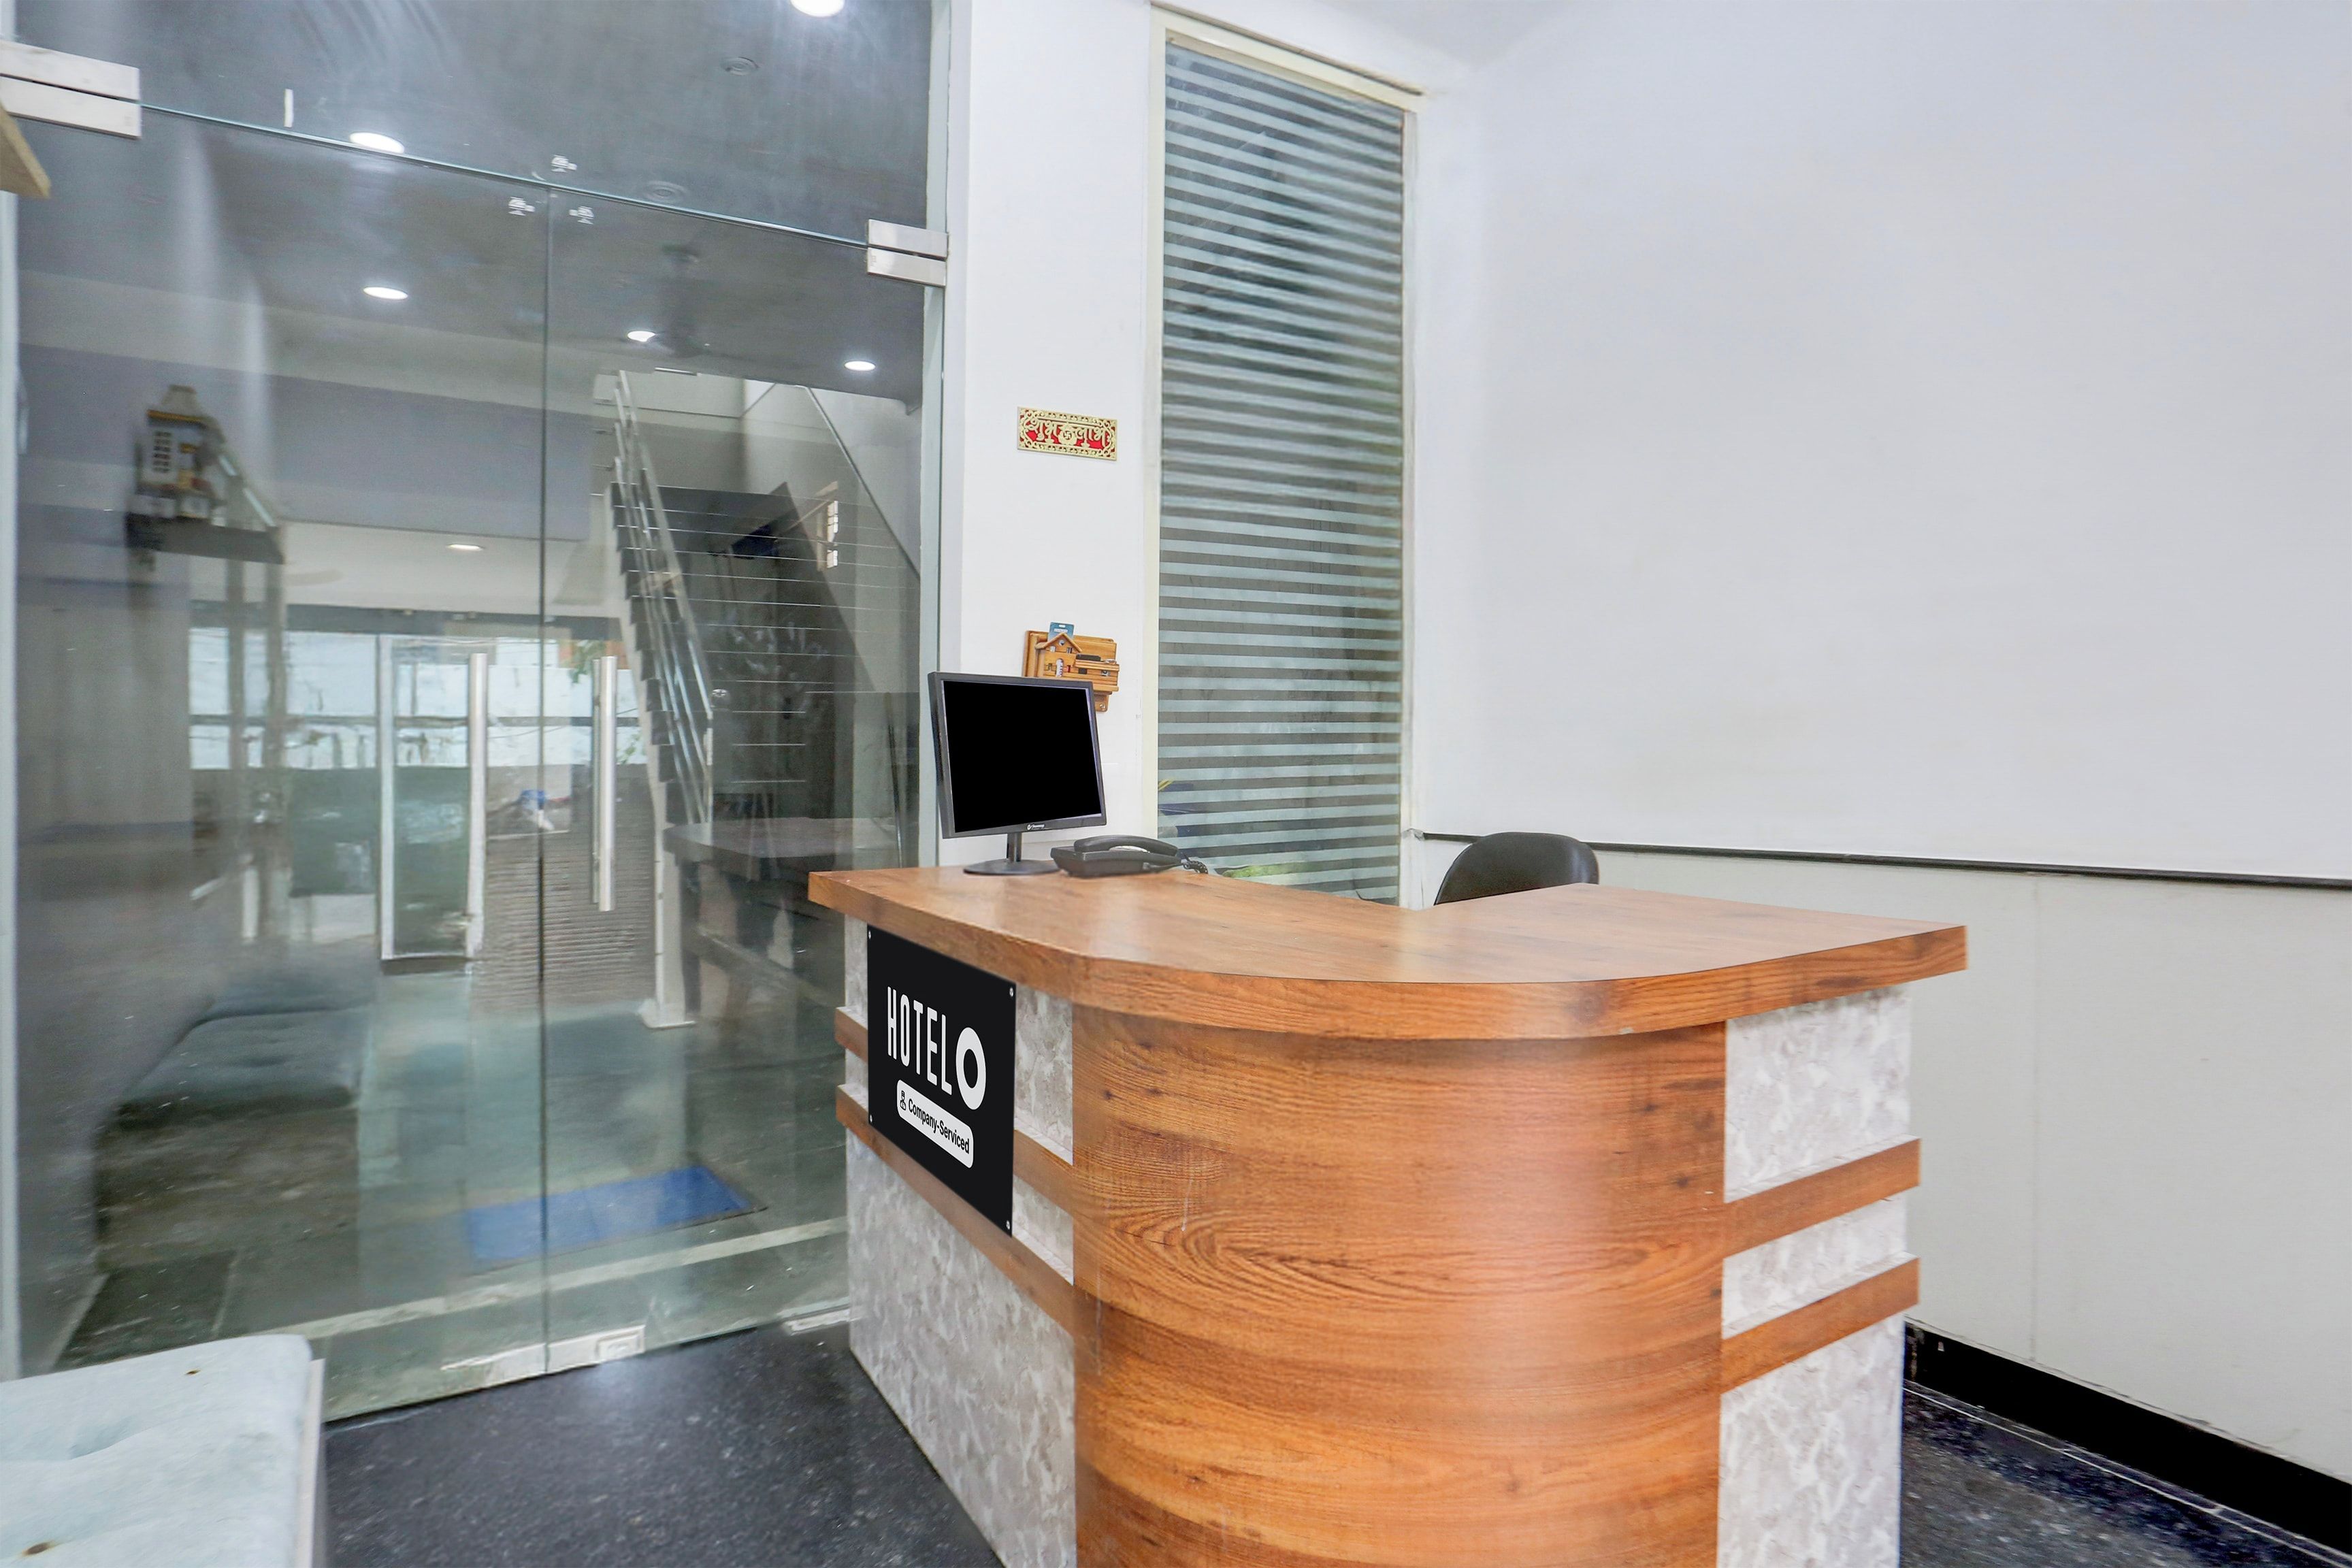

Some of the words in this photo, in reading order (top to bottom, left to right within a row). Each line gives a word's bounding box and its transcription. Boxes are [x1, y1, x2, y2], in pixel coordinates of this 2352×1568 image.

[1026, 418, 1059, 444] शुभ
[1075, 423, 1107, 448] लाभ
[909, 1098, 969, 1154] Company-Serviced
